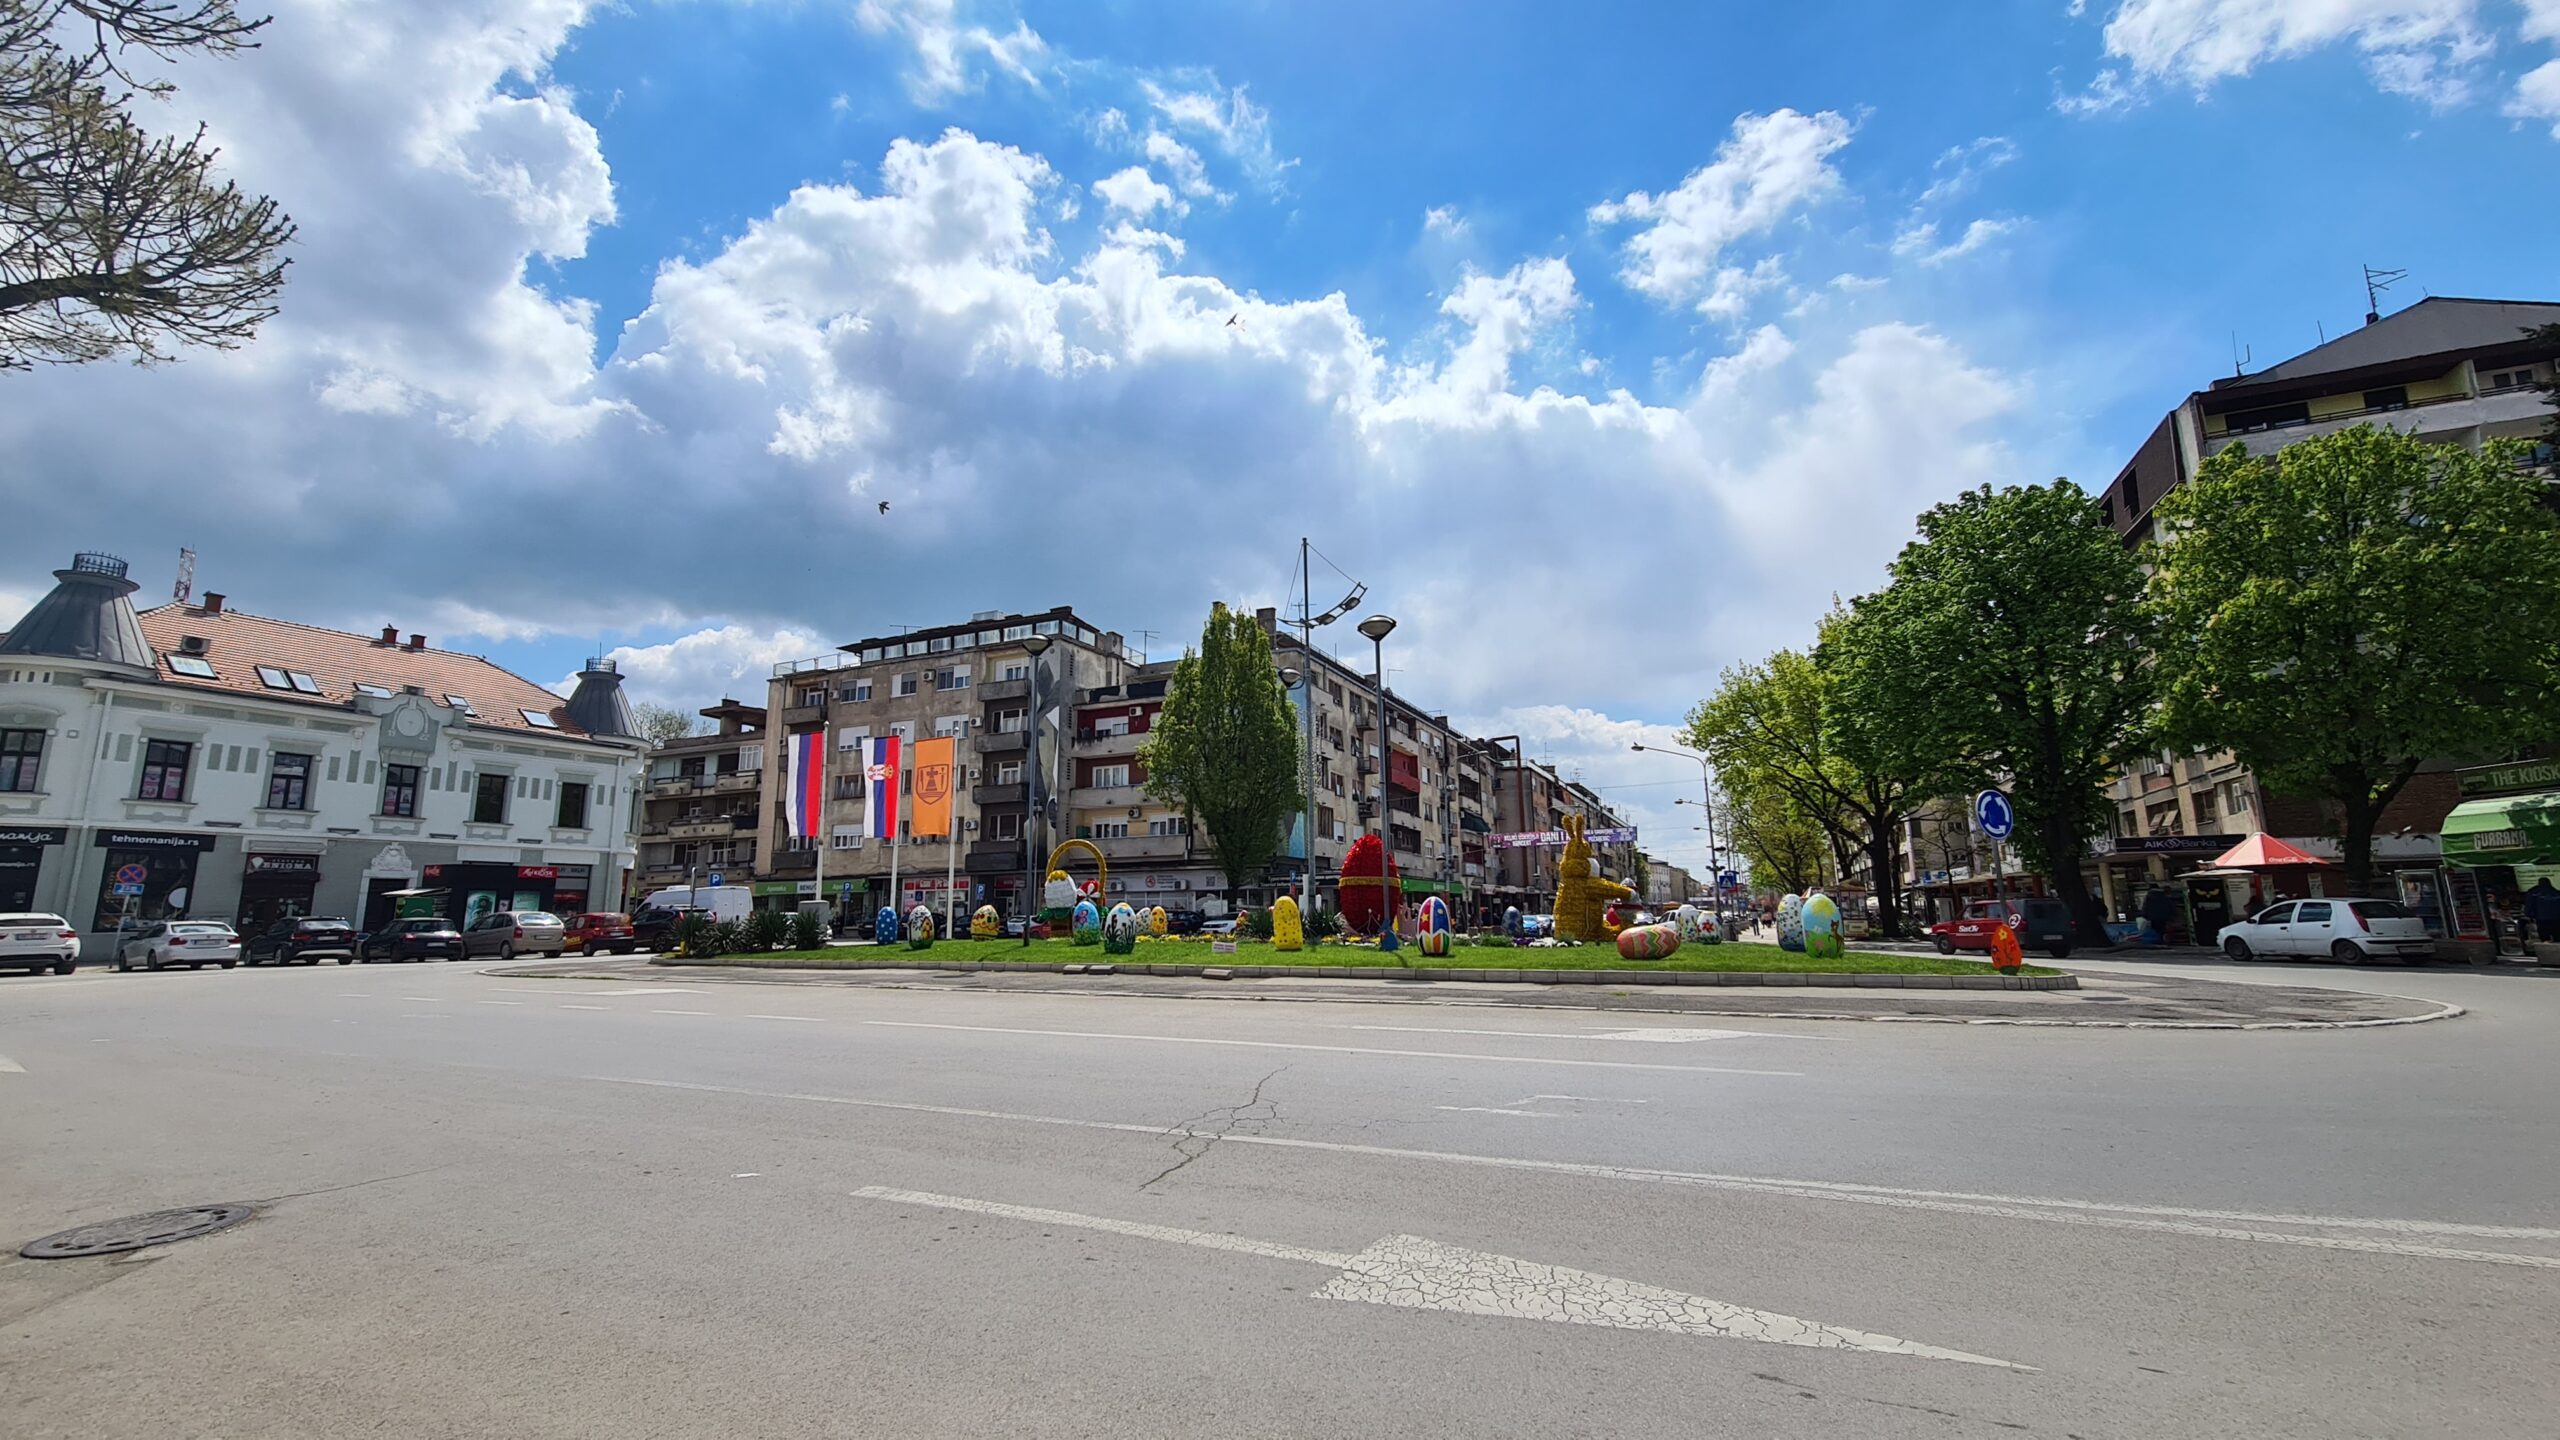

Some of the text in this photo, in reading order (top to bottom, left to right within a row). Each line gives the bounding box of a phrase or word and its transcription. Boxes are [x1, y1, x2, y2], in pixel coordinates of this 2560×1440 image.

[2489, 770, 2518, 786] THE
[2519, 763, 2560, 784] KIOSK
[112, 834, 200, 847] tehnomanija.rs
[2144, 841, 2164, 849] AIK
[2473, 830, 2527, 850] GUARANA
[712, 874, 720, 884] P
